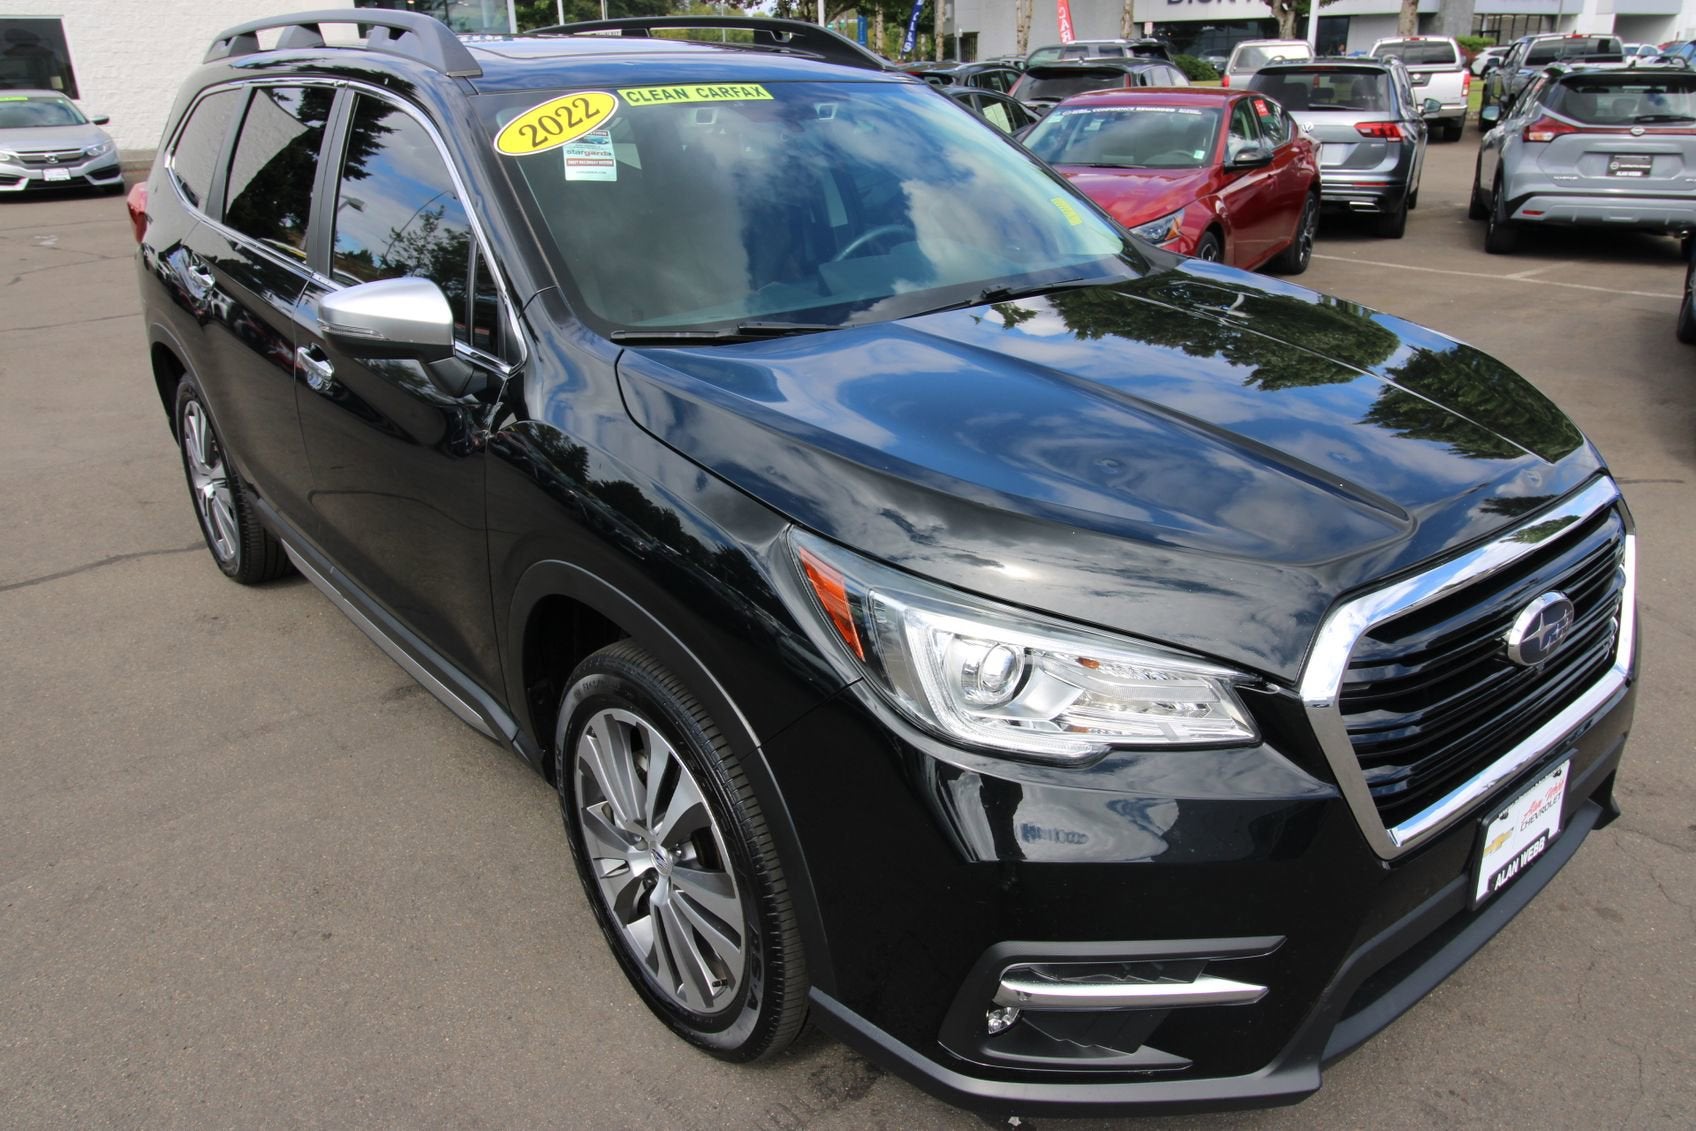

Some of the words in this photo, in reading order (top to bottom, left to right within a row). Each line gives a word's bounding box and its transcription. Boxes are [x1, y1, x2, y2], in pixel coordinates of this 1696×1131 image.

[626, 88, 690, 102] CLEAN
[695, 86, 766, 98] CARFAX
[518, 97, 600, 148] 2022
[1520, 792, 1561, 831] CHEVROLET
[1494, 857, 1519, 891] ALAN
[1520, 836, 1546, 868] WEBB
